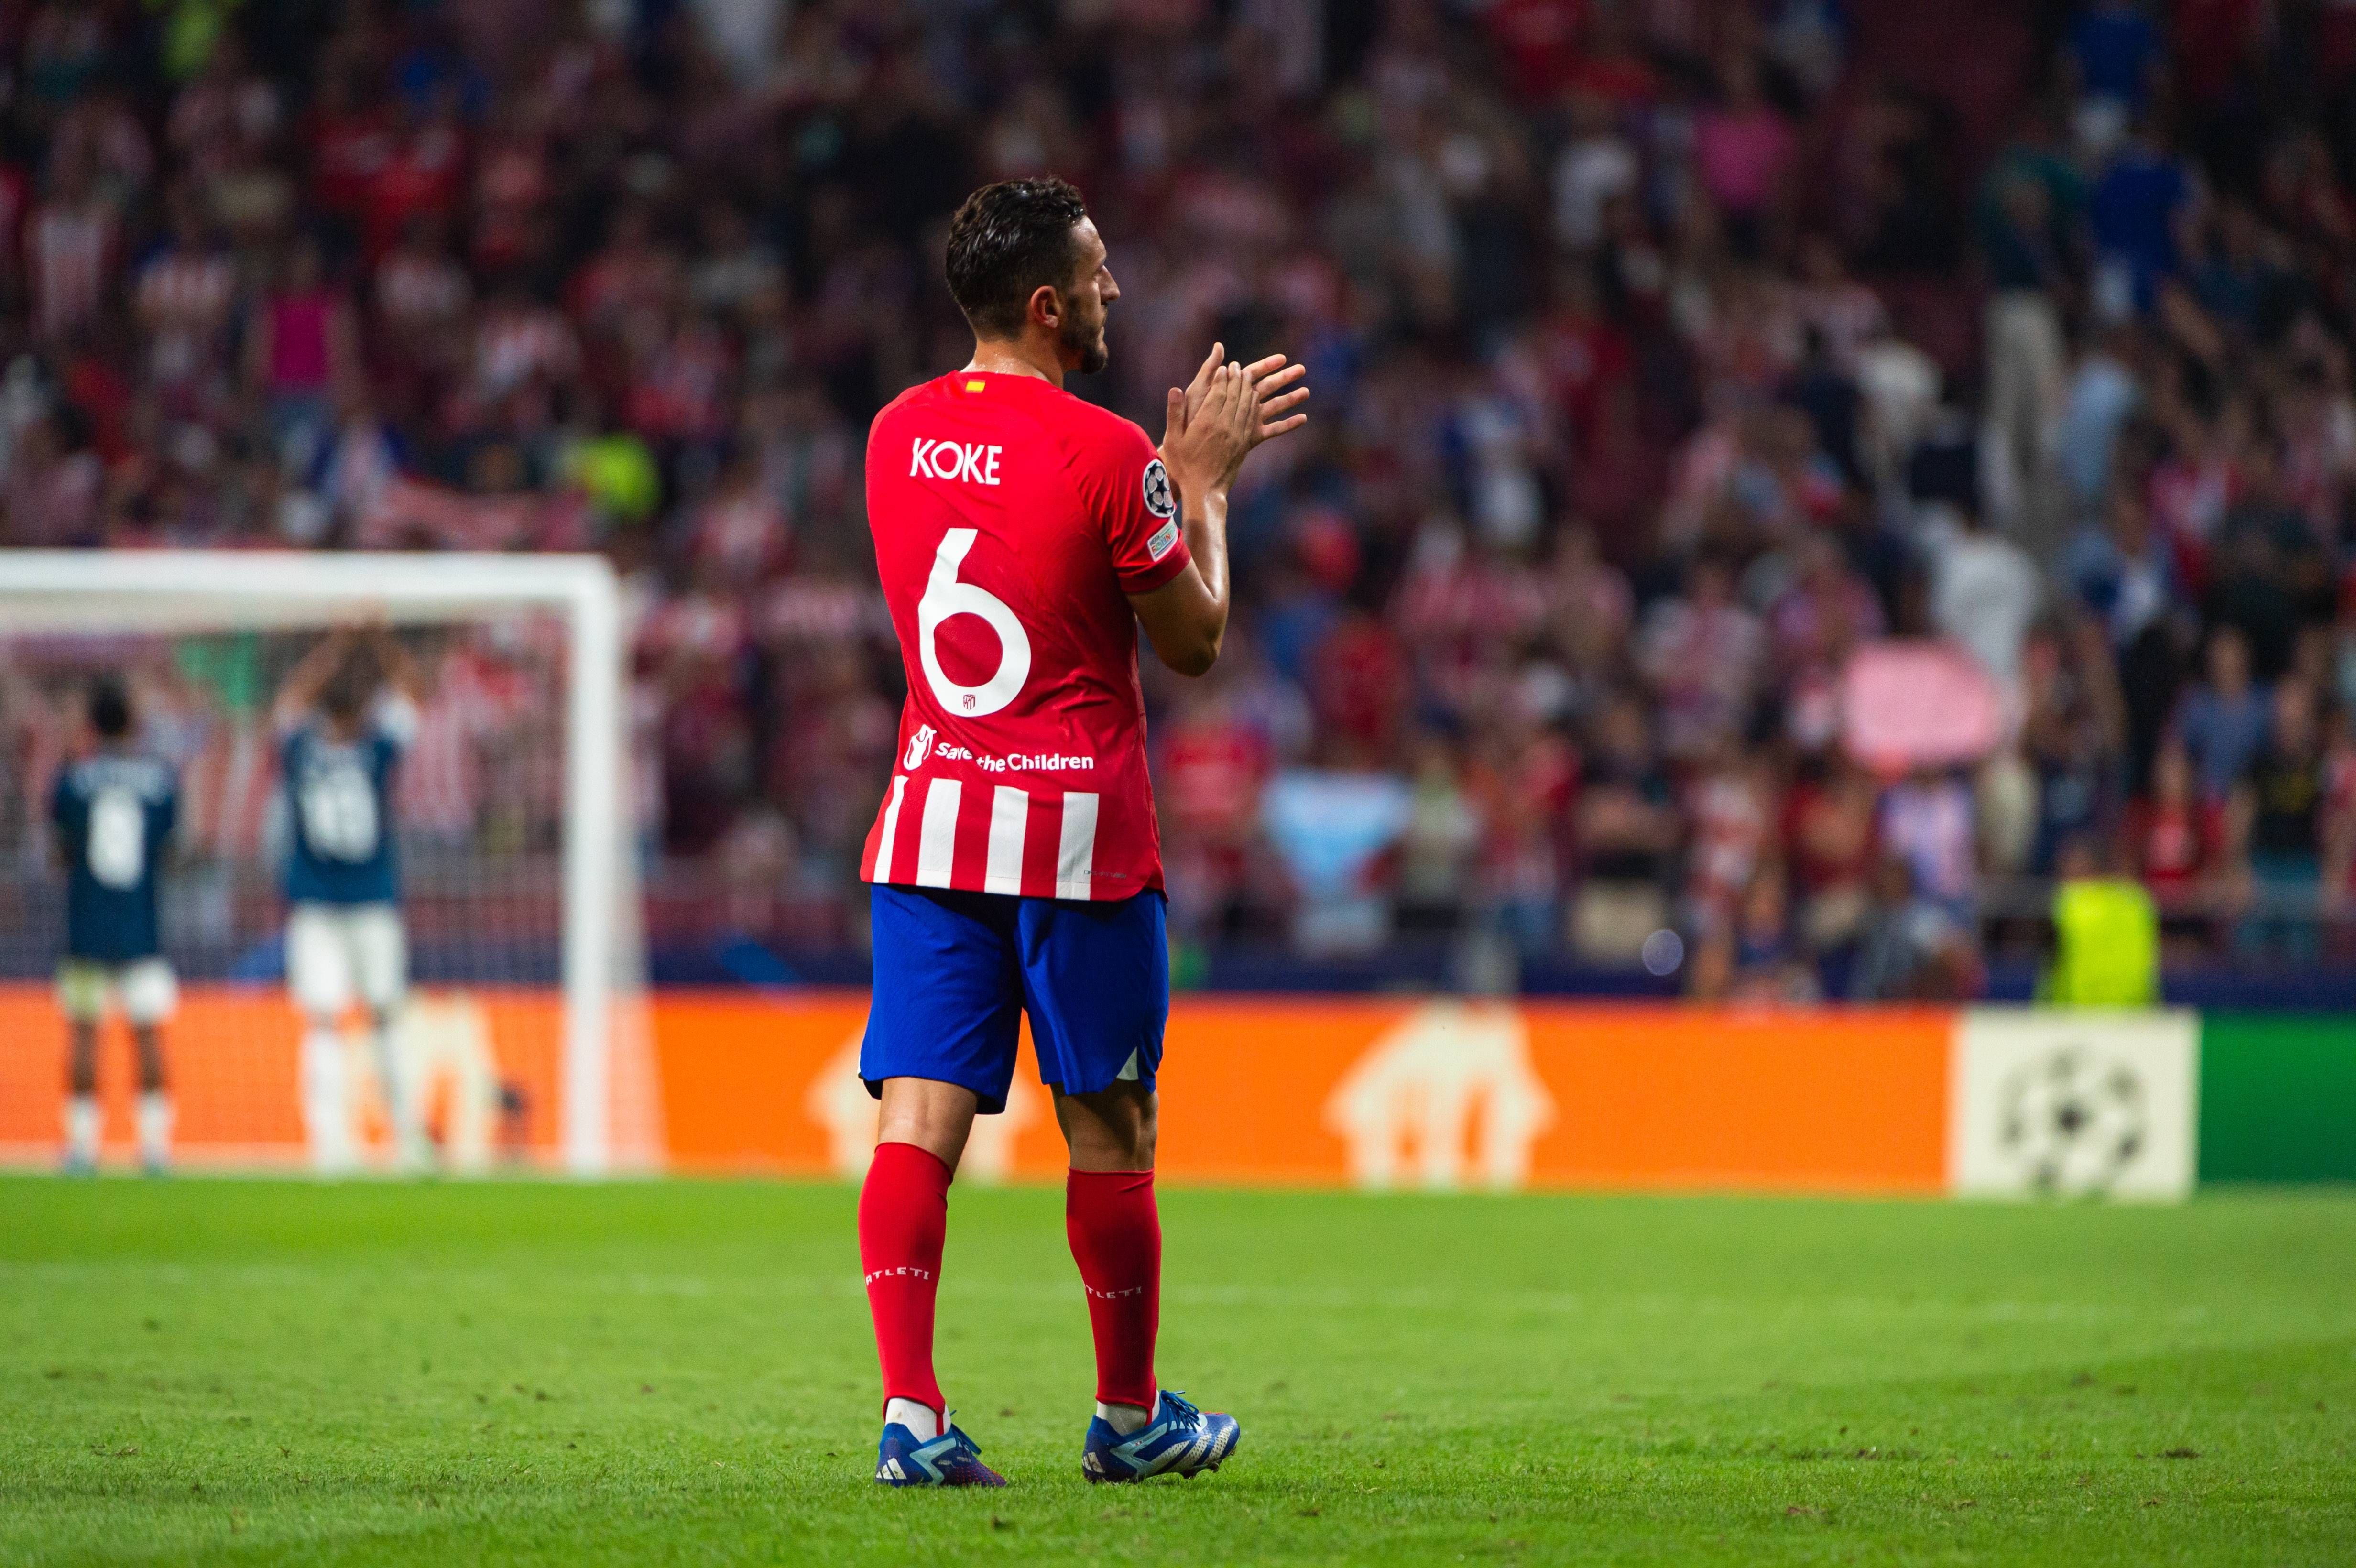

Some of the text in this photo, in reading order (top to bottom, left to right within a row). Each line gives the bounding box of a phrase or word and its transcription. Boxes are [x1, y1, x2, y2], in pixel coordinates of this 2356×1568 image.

[909, 438, 1002, 485] KOKE
[918, 528, 1031, 718] 6
[934, 742, 1094, 772] Save the Children
[865, 1267, 929, 1286] ATLETI
[1085, 1284, 1142, 1299] TLETI
